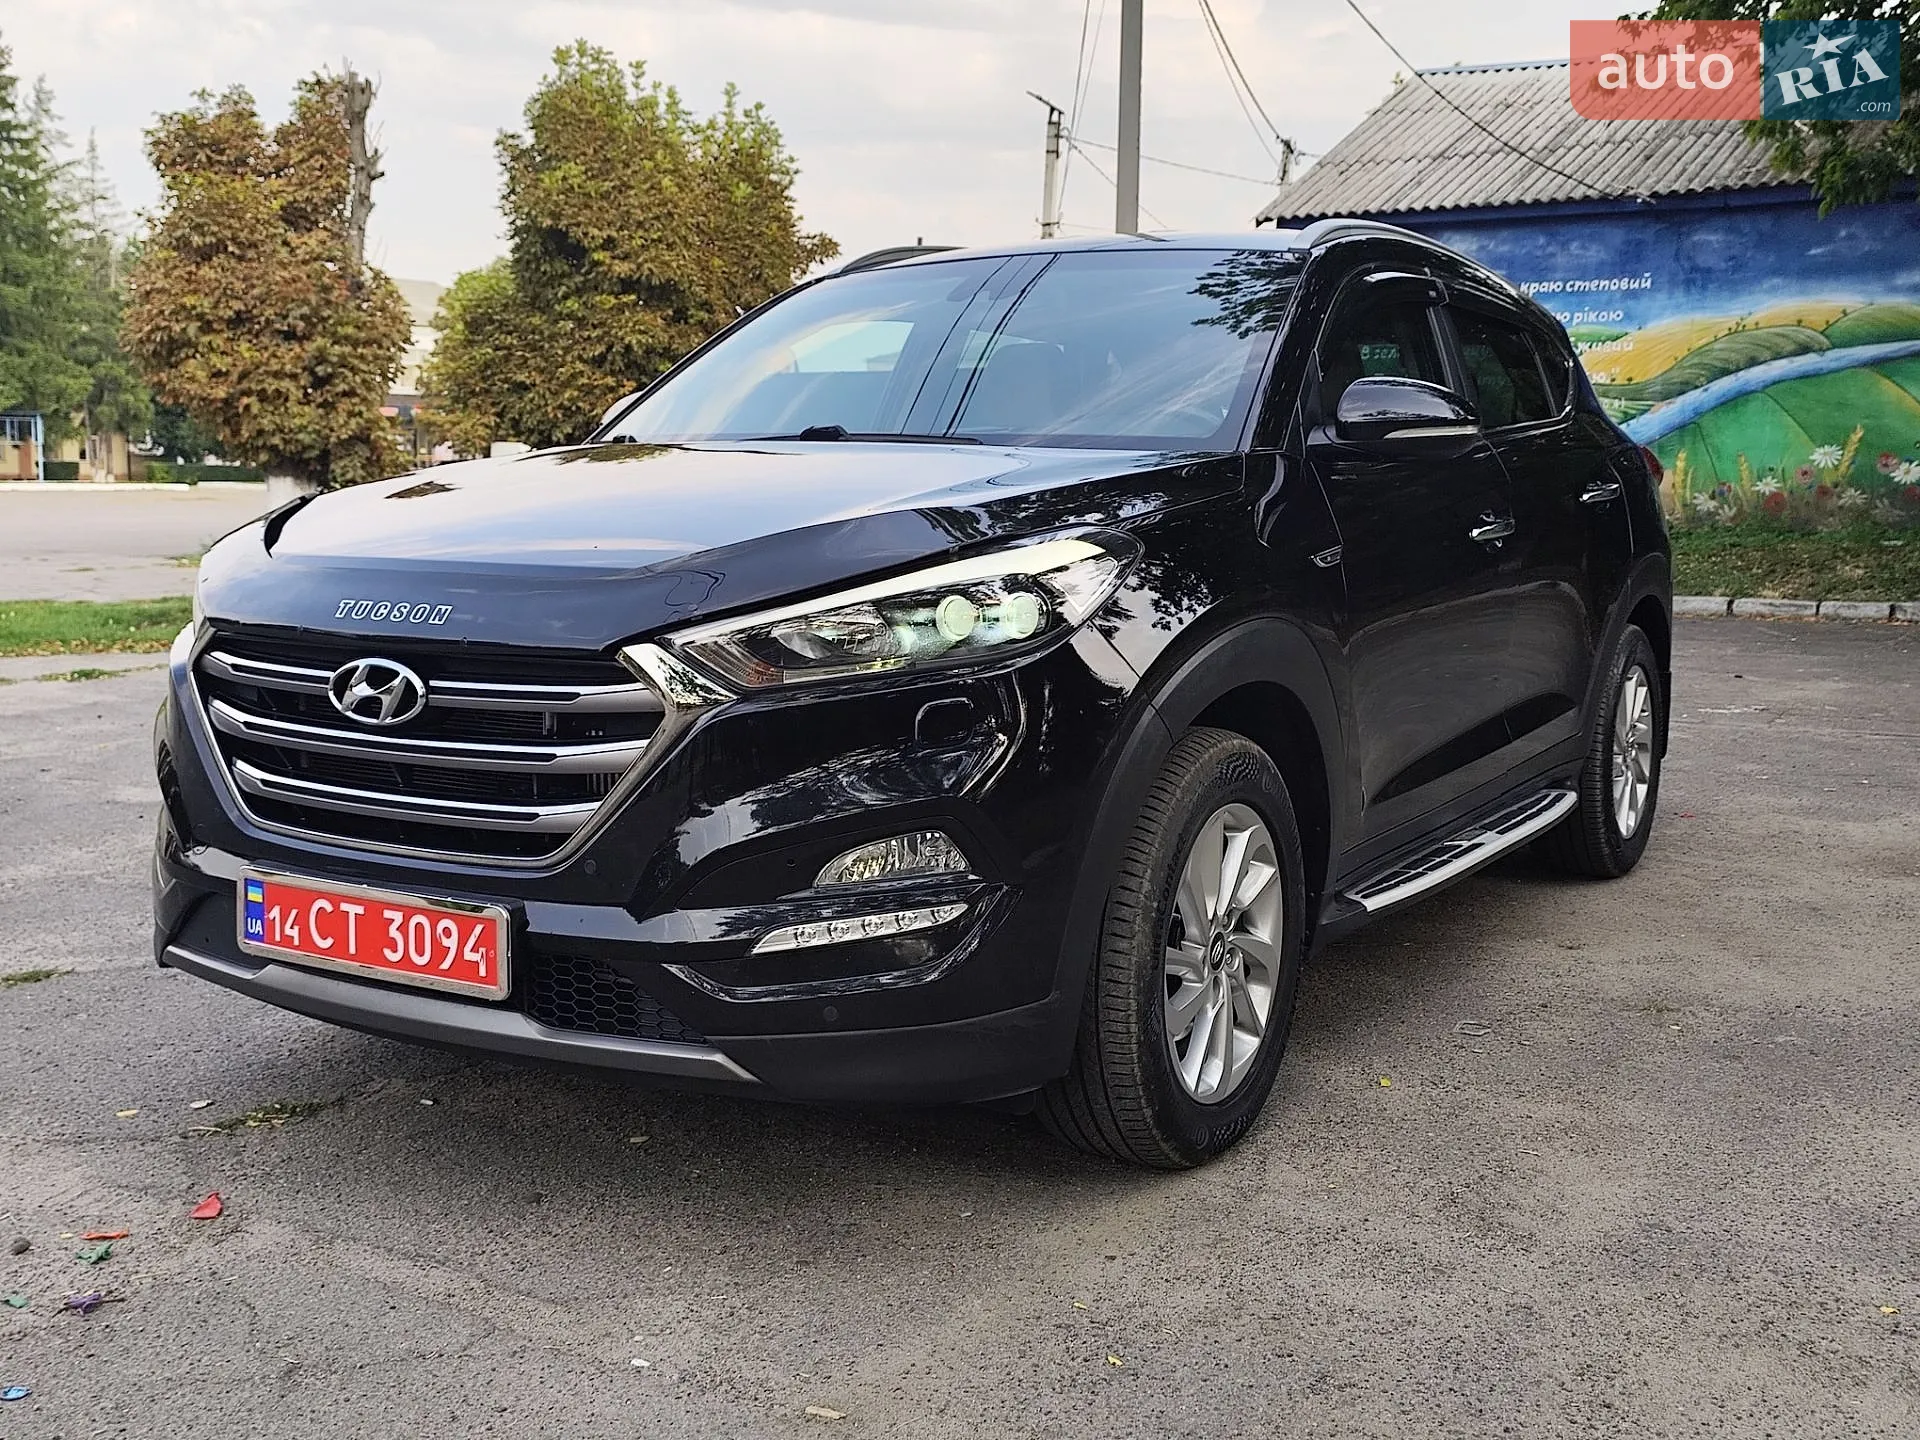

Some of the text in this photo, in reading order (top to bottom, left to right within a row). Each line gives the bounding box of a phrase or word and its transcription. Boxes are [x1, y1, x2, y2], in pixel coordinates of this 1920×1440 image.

[1520, 272, 1652, 297] краю степовий
[1572, 306, 1624, 326] рікою
[335, 599, 453, 625] TUCSON
[247, 917, 264, 935] UA
[382, 909, 487, 977] 3094
